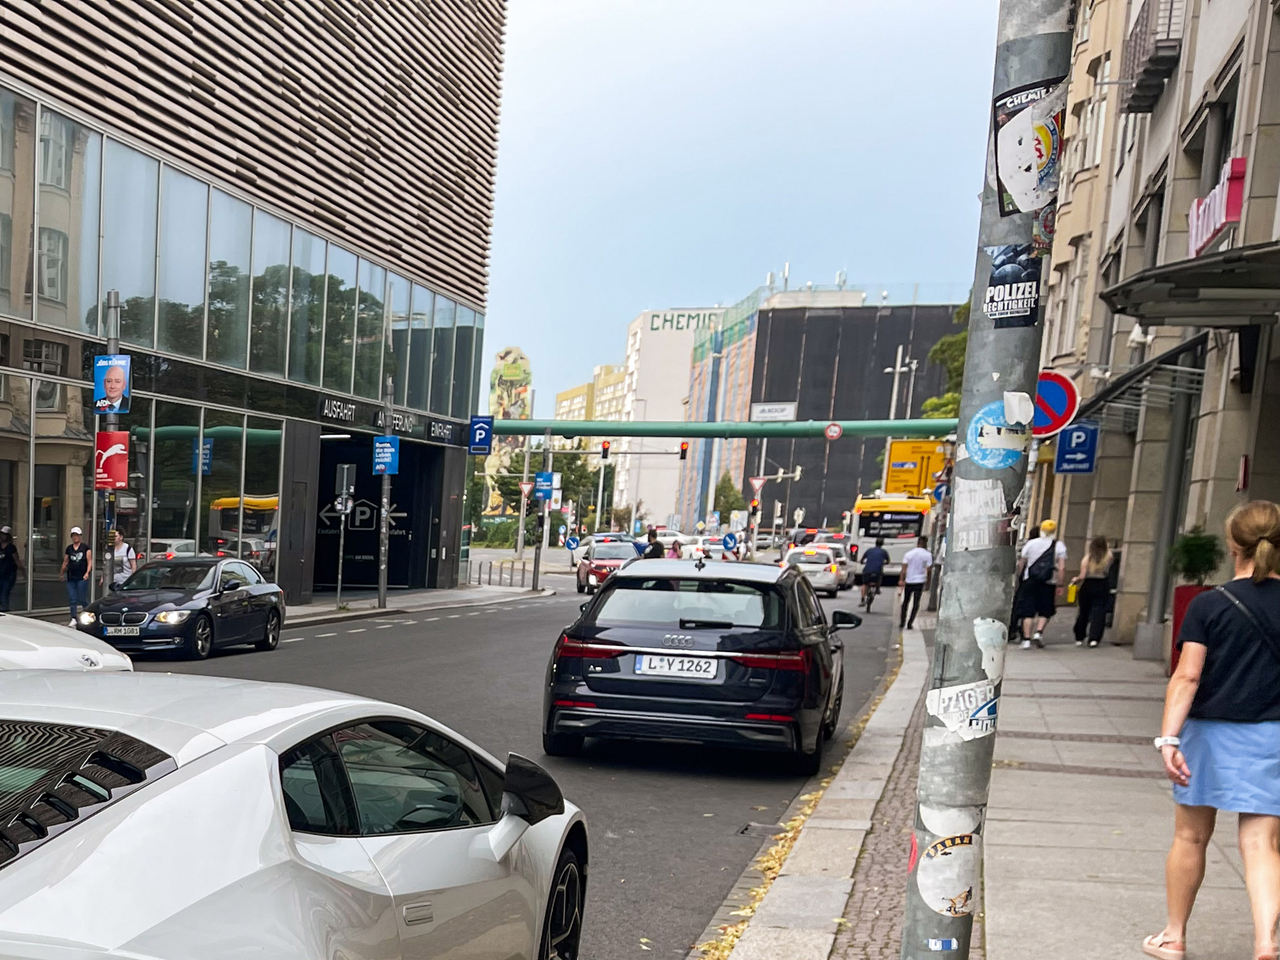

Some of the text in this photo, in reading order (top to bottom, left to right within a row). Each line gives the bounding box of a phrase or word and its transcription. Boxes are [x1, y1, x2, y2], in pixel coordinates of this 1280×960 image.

[324, 399, 355, 422] AUSFAHRT
[475, 430, 486, 442] P
[1071, 431, 1086, 448] P
[648, 656, 712, 673] L Y 1262
